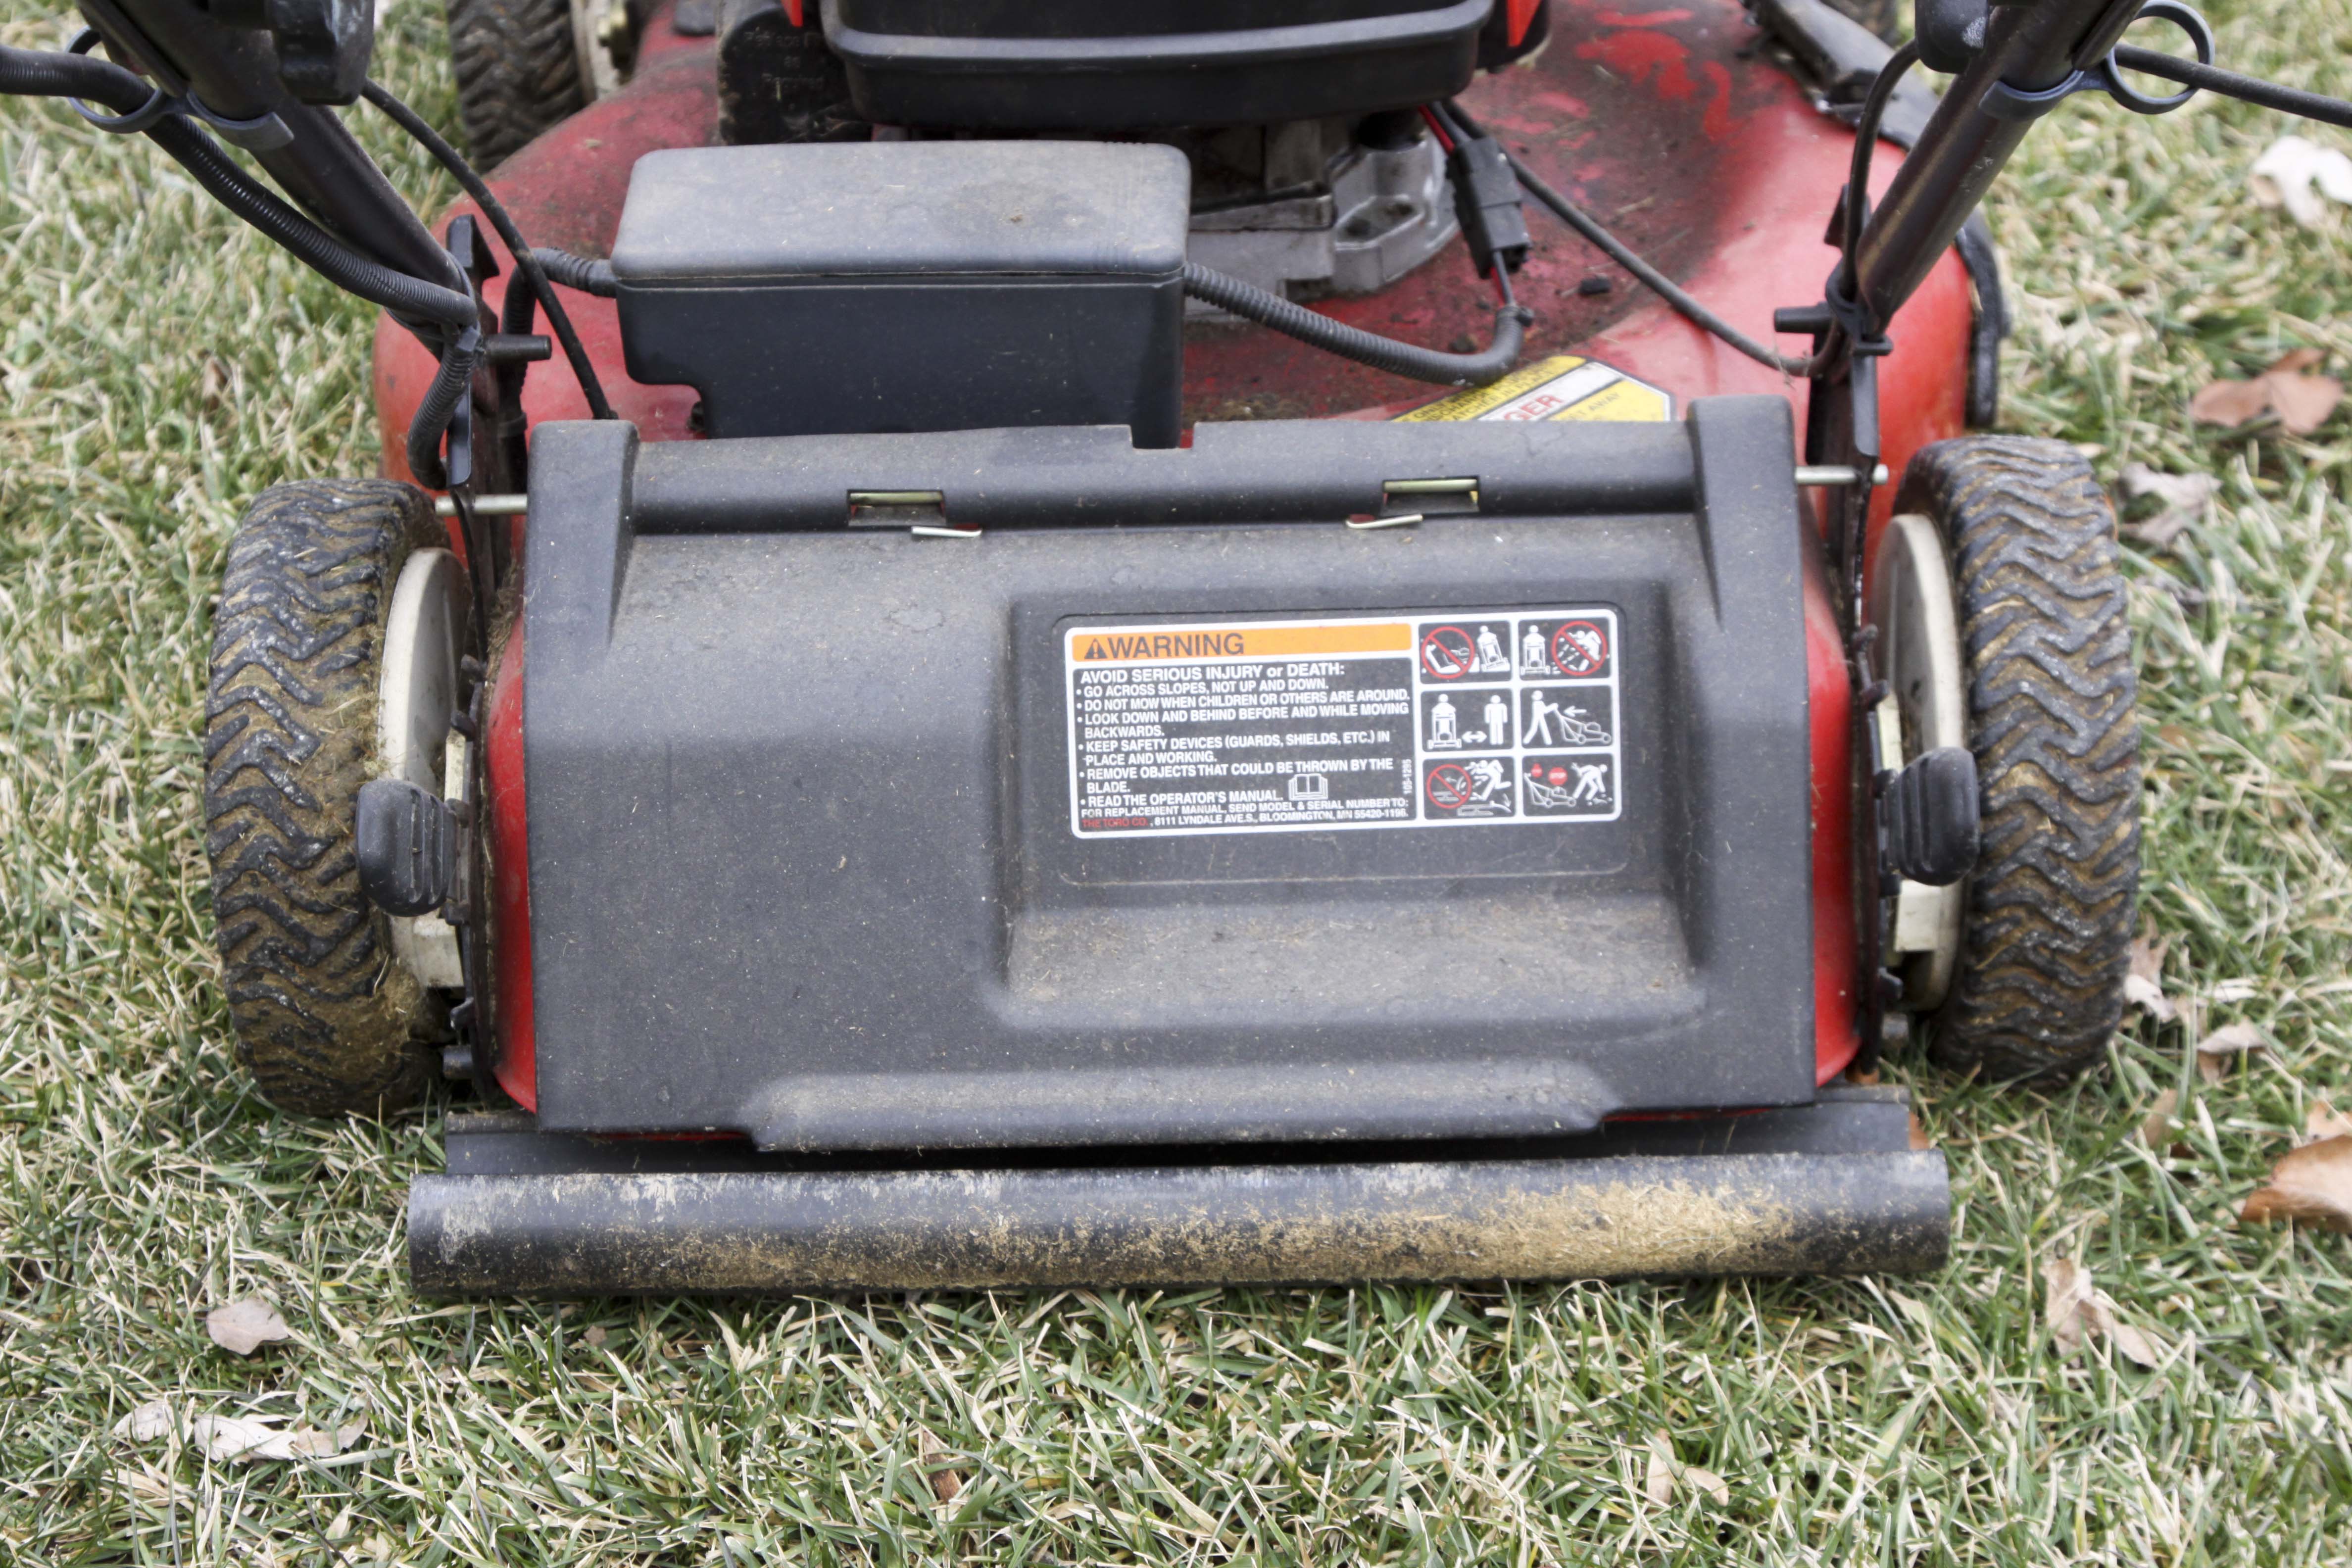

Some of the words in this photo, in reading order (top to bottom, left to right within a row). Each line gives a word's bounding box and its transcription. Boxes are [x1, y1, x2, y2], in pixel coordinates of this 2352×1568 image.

[1107, 633, 1244, 659] WARNING
[1080, 670, 1127, 684] AVOID
[1132, 667, 1201, 682] SERIOUS
[1206, 664, 1263, 679] INJURY
[1267, 667, 1283, 677] or
[1287, 662, 1345, 676] DEATH:
[1084, 686, 1102, 697] GO
[1105, 684, 1155, 697] ACROSS
[1158, 682, 1209, 694] SLOPES,
[1212, 681, 1236, 692] NOT
[1239, 681, 1256, 692] UP
[1259, 679, 1285, 691] AND
[1288, 678, 1328, 690] DOWN.
[1085, 699, 1101, 711] DO
[1104, 699, 1128, 710] NOT
[1131, 697, 1159, 710] MOW
[1161, 696, 1195, 708] WHEN
[1198, 693, 1257, 707] CHILDREN
[1260, 693, 1277, 705] OR
[1279, 692, 1327, 704] OTHERS
[1329, 691, 1354, 703] ARE
[1357, 689, 1410, 701] AROUND.
[1085, 713, 1119, 725] LOOK
[1122, 712, 1158, 724] DOWN
[1162, 711, 1187, 722] AND
[1191, 709, 1235, 721] BEHIND
[1239, 707, 1288, 720] BEFORE
[1291, 706, 1318, 717] AND
[1320, 704, 1358, 717] WHILE
[1361, 702, 1408, 715] MOVING
[1085, 726, 1165, 738] BACKWARDS.
[1086, 741, 1118, 752] KEEP
[1121, 738, 1167, 751] SAFETY
[1171, 737, 1222, 750] DEVICES
[1225, 735, 1283, 749] (GUARDS,
[1286, 733, 1341, 745] SHIELDS,
[1343, 730, 1374, 744] ETC.)
[1377, 731, 1390, 742] IN
[1086, 754, 1125, 766] PLACE
[1128, 752, 1154, 765] AND
[1156, 750, 1217, 764] WORKING.
[1087, 768, 1137, 780] REMOVE
[1140, 766, 1196, 778] OBJECTS
[1197, 764, 1228, 776] THAT
[1231, 762, 1274, 776] COULD
[1276, 762, 1293, 773] BE
[1295, 760, 1347, 773] THROWN
[1350, 759, 1367, 771] BY
[1369, 758, 1393, 770] THE
[1087, 781, 1130, 794] BLADE.
[1089, 795, 1121, 807] READ
[1123, 794, 1147, 806] THE
[1150, 791, 1226, 805] OPERATOR'S
[1229, 789, 1283, 803] MANUAL.
[1081, 809, 1102, 818] FOR
[1105, 806, 1179, 817] REPLACEMENT
[1181, 804, 1227, 815] MANUAL,
[1228, 802, 1256, 813] SEND
[1259, 802, 1295, 812] MODEL
[1297, 801, 1305, 810] &
[1307, 799, 1344, 810] SERIAL
[1346, 798, 1389, 809] NUMBER
[1391, 797, 1408, 807] TO:
[1082, 819, 1100, 828] THE
[1102, 818, 1129, 827] TORO
[1131, 817, 1148, 826] CO.
[1155, 816, 1176, 826] 8111
[1178, 814, 1223, 825] LYNDALE
[1259, 811, 1335, 822] BLOOMINGTON,
[1337, 810, 1353, 819] MN
